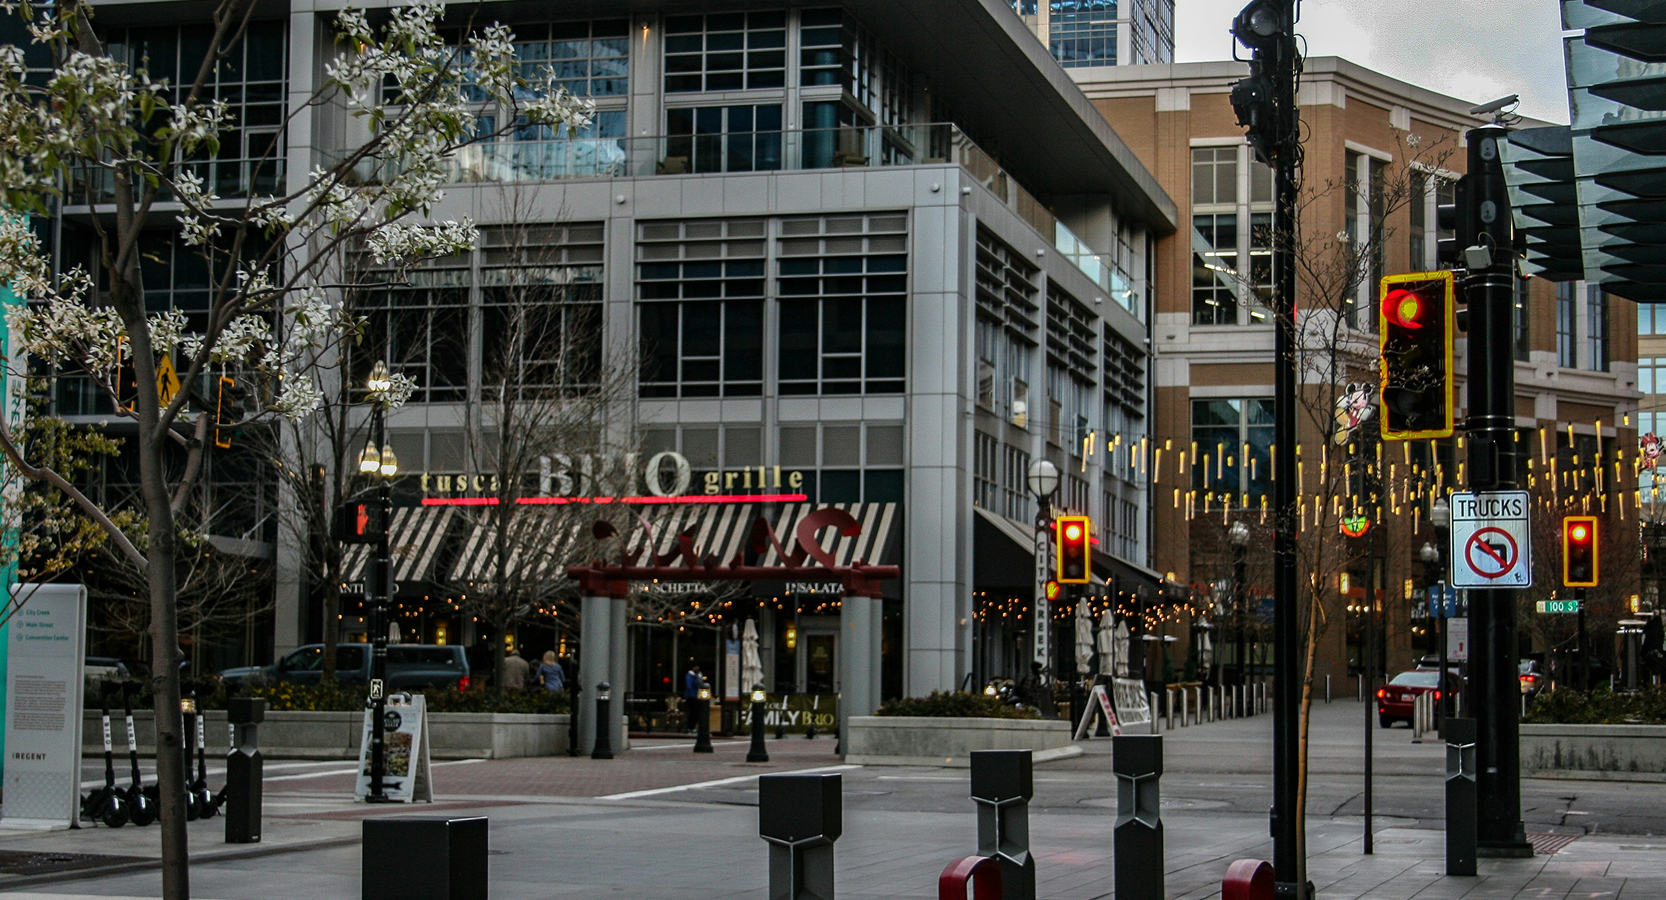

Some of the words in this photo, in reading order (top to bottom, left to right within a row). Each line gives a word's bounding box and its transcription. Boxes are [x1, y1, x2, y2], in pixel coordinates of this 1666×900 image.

[704, 465, 803, 495] grille
[1457, 499, 1522, 517] TRUCKS
[1037, 542, 1046, 589] CITY
[1550, 601, 1564, 612] 100
[1567, 602, 1574, 612] S
[1037, 597, 1046, 657] CREEK
[15, 752, 47, 760] REGENT
